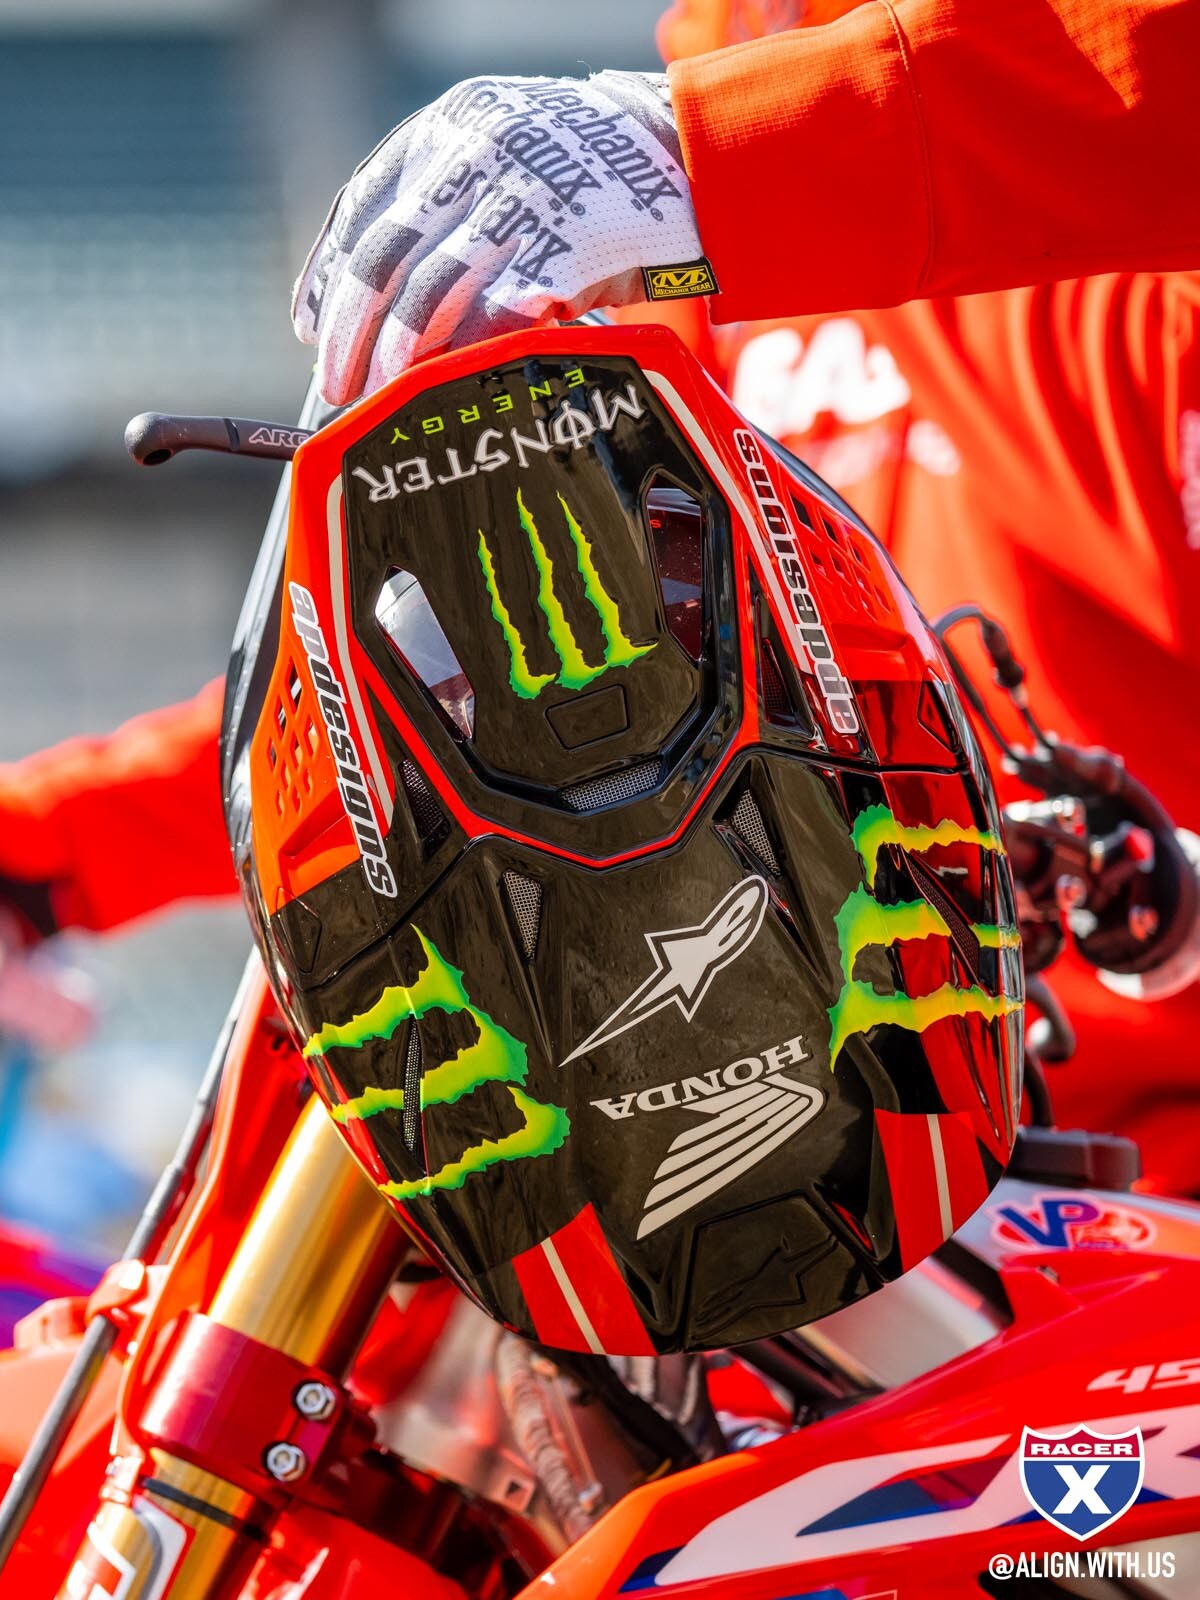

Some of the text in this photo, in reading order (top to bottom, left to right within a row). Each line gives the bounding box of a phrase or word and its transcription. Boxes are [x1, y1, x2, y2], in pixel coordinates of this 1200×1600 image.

[654, 282, 711, 296] MECHANIX WEAR
[389, 367, 586, 445] ENERGY
[733, 428, 859, 734] apdesigns
[288, 581, 398, 898] apdesigns
[589, 1034, 809, 1121] HONDA
[996, 1198, 1101, 1249] VP
